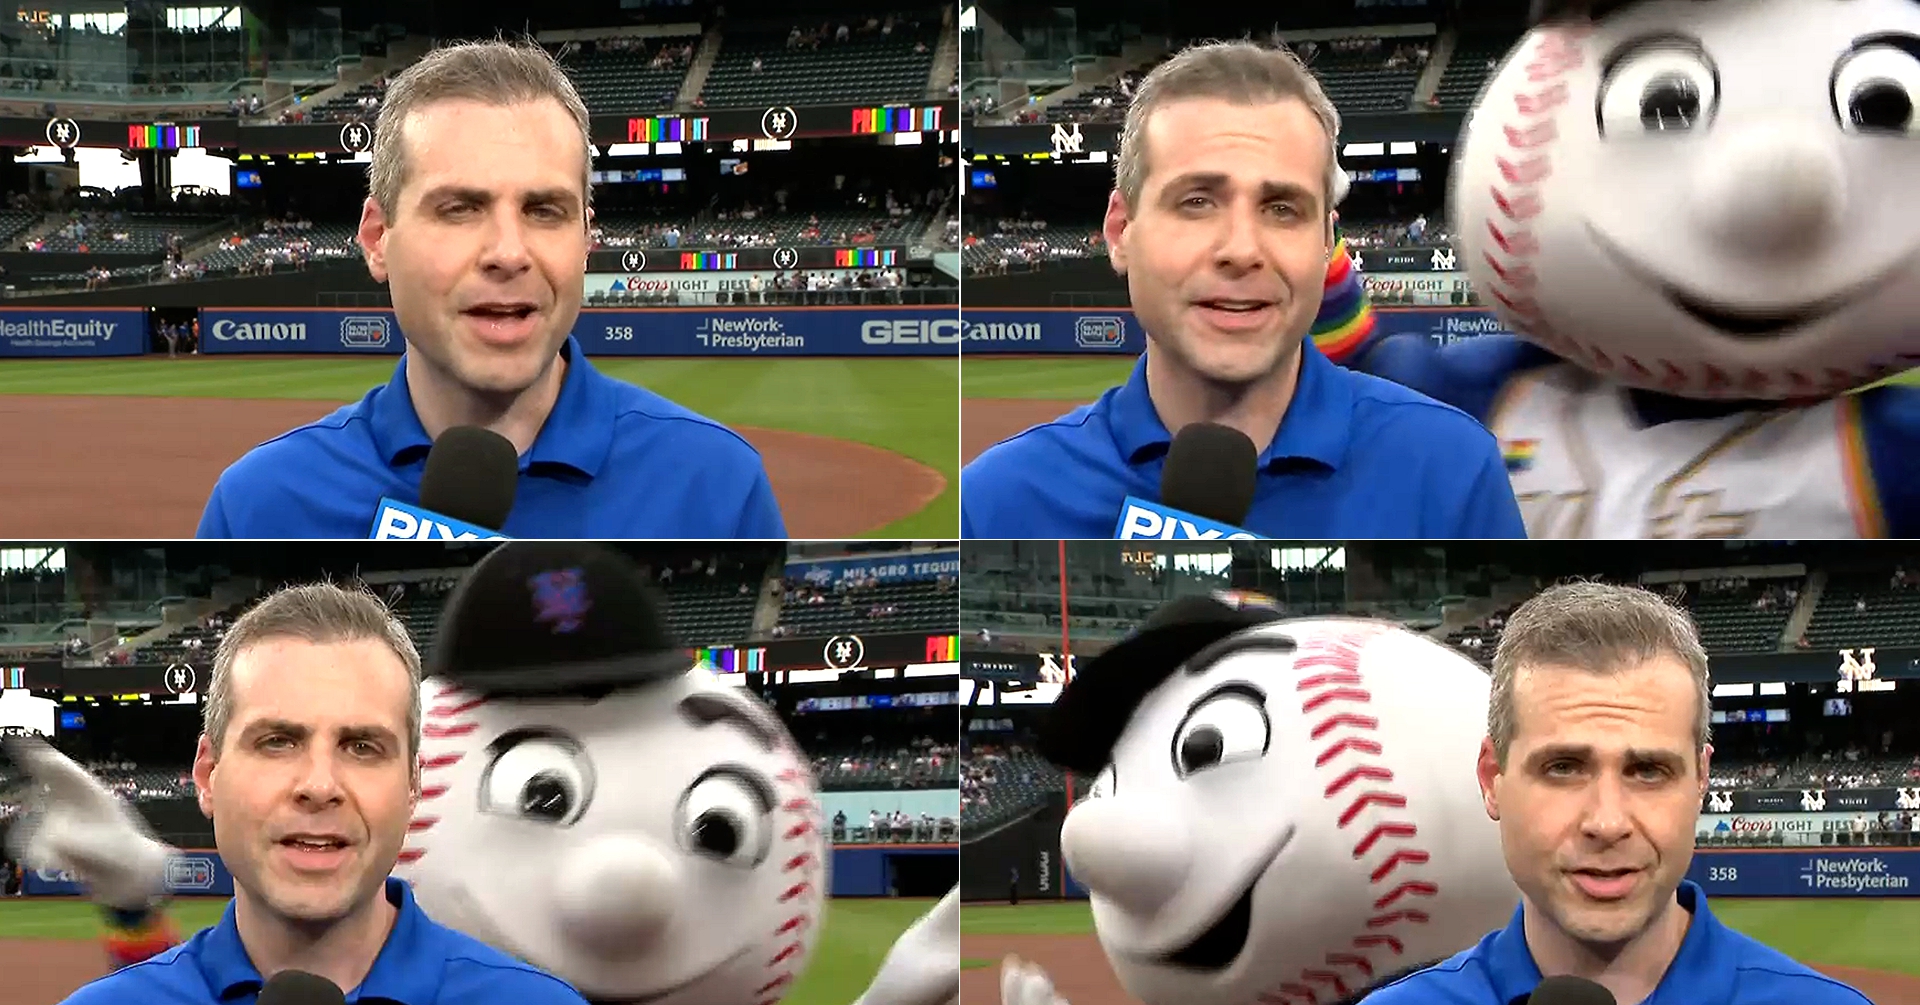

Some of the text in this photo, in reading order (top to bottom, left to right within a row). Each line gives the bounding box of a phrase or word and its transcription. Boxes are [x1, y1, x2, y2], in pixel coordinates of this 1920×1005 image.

[627, 276, 668, 290] Coors
[671, 280, 709, 290] LIGHT
[212, 319, 306, 341] Canon
[712, 318, 784, 332] NewYork-
[605, 327, 633, 340] 358
[712, 333, 805, 351] Presbyterian
[844, 564, 907, 579] MILAGRO
[1731, 816, 1773, 831] Coors
[1775, 820, 1813, 831] LIGHT
[1816, 858, 1888, 872] NewYork-
[1709, 867, 1738, 881] 358
[1816, 874, 1909, 892] Presbyterian
